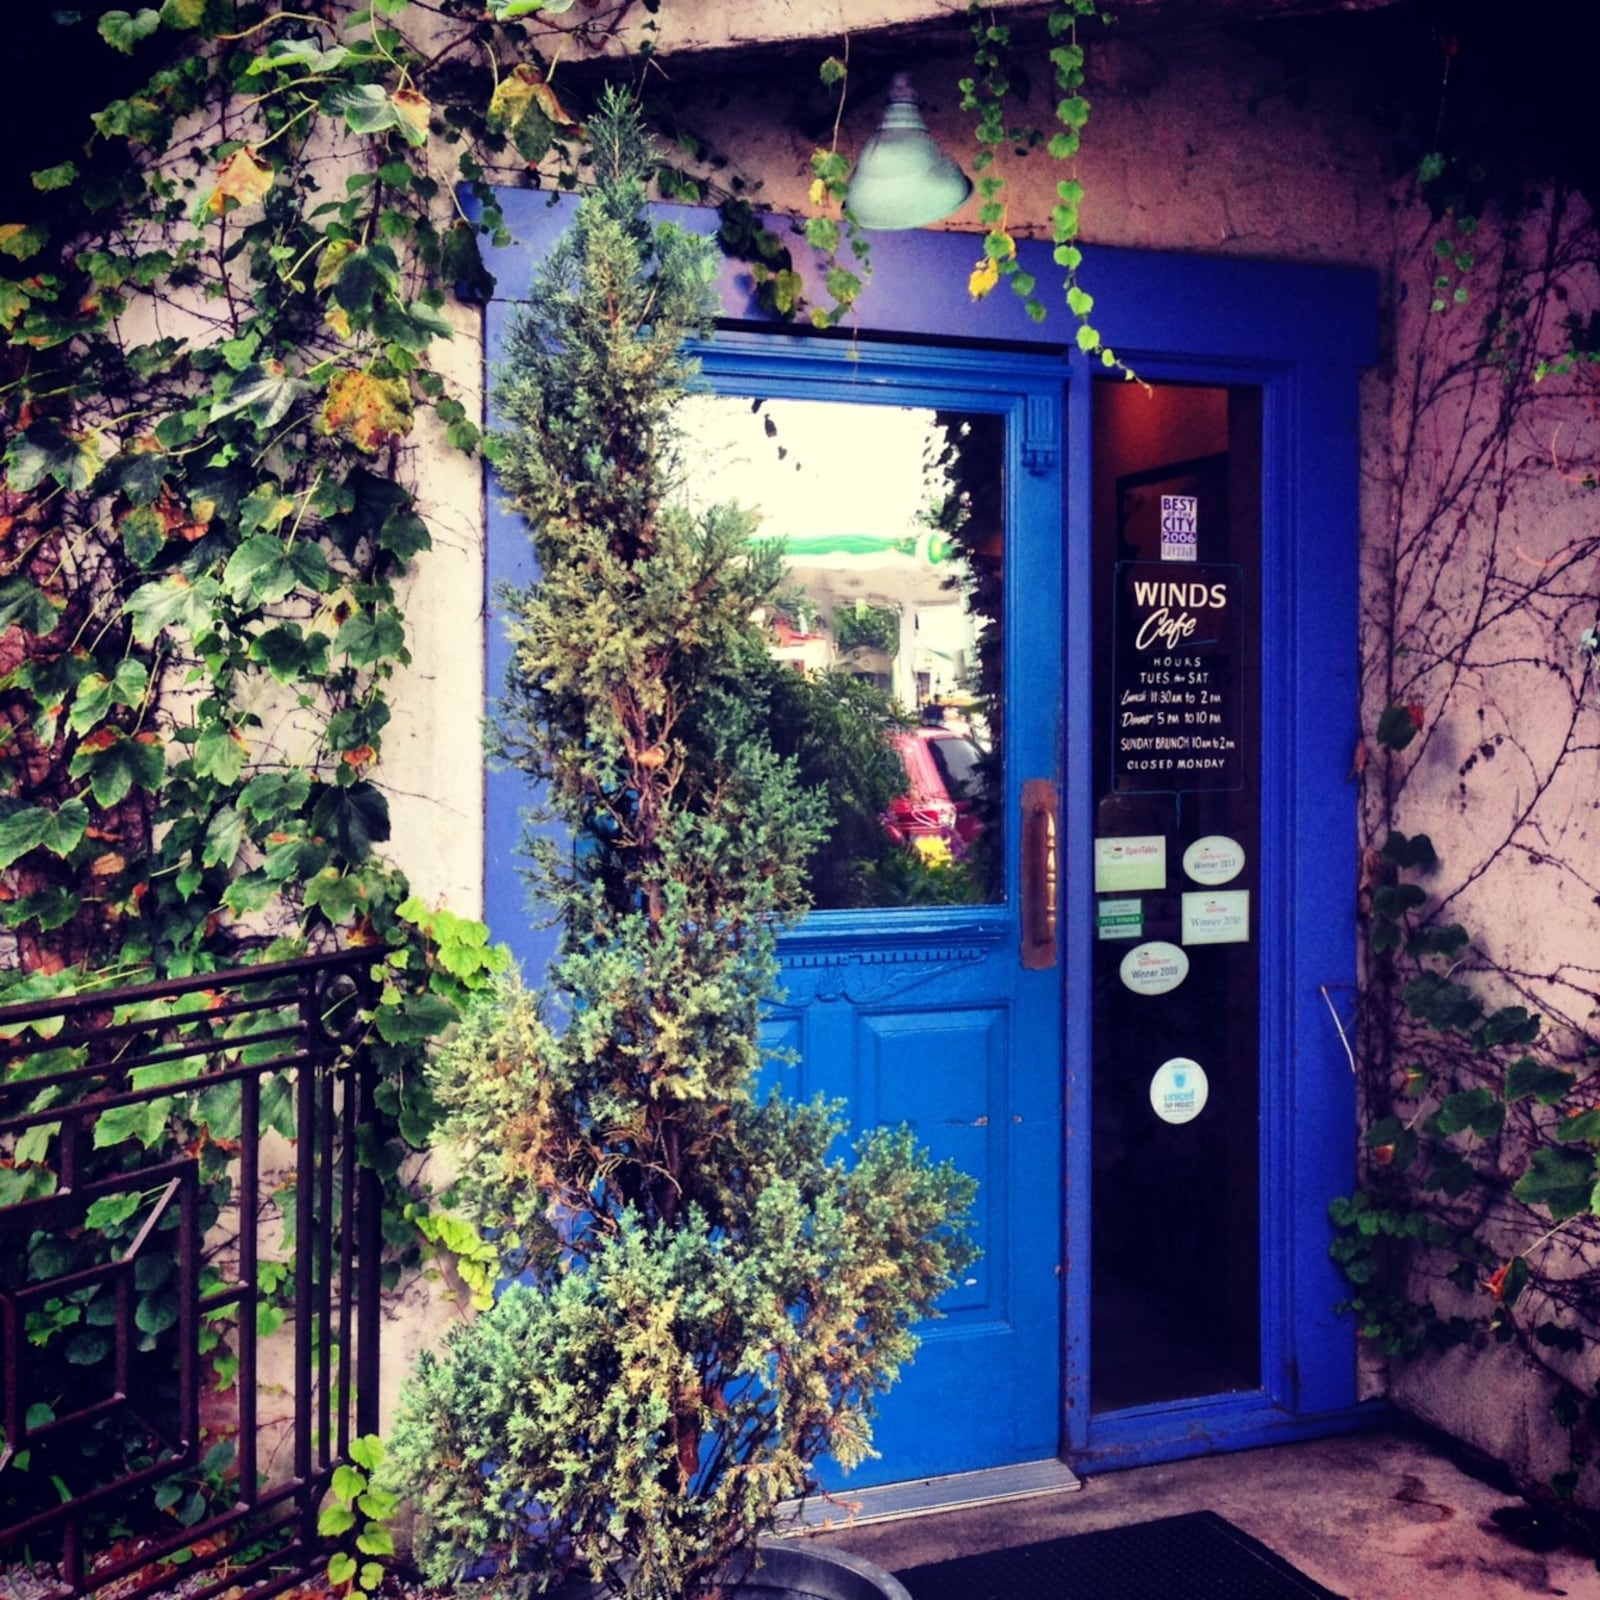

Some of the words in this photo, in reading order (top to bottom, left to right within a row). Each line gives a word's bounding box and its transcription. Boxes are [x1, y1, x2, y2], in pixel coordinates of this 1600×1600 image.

[1163, 497, 1195, 511] BEST
[1163, 517, 1194, 532] CITY
[1162, 532, 1196, 543] 2006
[1134, 581, 1227, 608] WINDS
[1136, 607, 1197, 650] Cafe
[1153, 657, 1201, 668] HOURS
[1187, 672, 1209, 684] SAT
[1185, 691, 1196, 703] to
[1120, 737, 1153, 751] SUNDAY
[1154, 736, 1189, 750] BRUNCH
[1126, 760, 1174, 770] CLOSED
[1176, 758, 1226, 769] MONDAY
[1193, 861, 1219, 870] Winner
[1190, 917, 1222, 927] Winner
[1131, 968, 1158, 979] Winner
